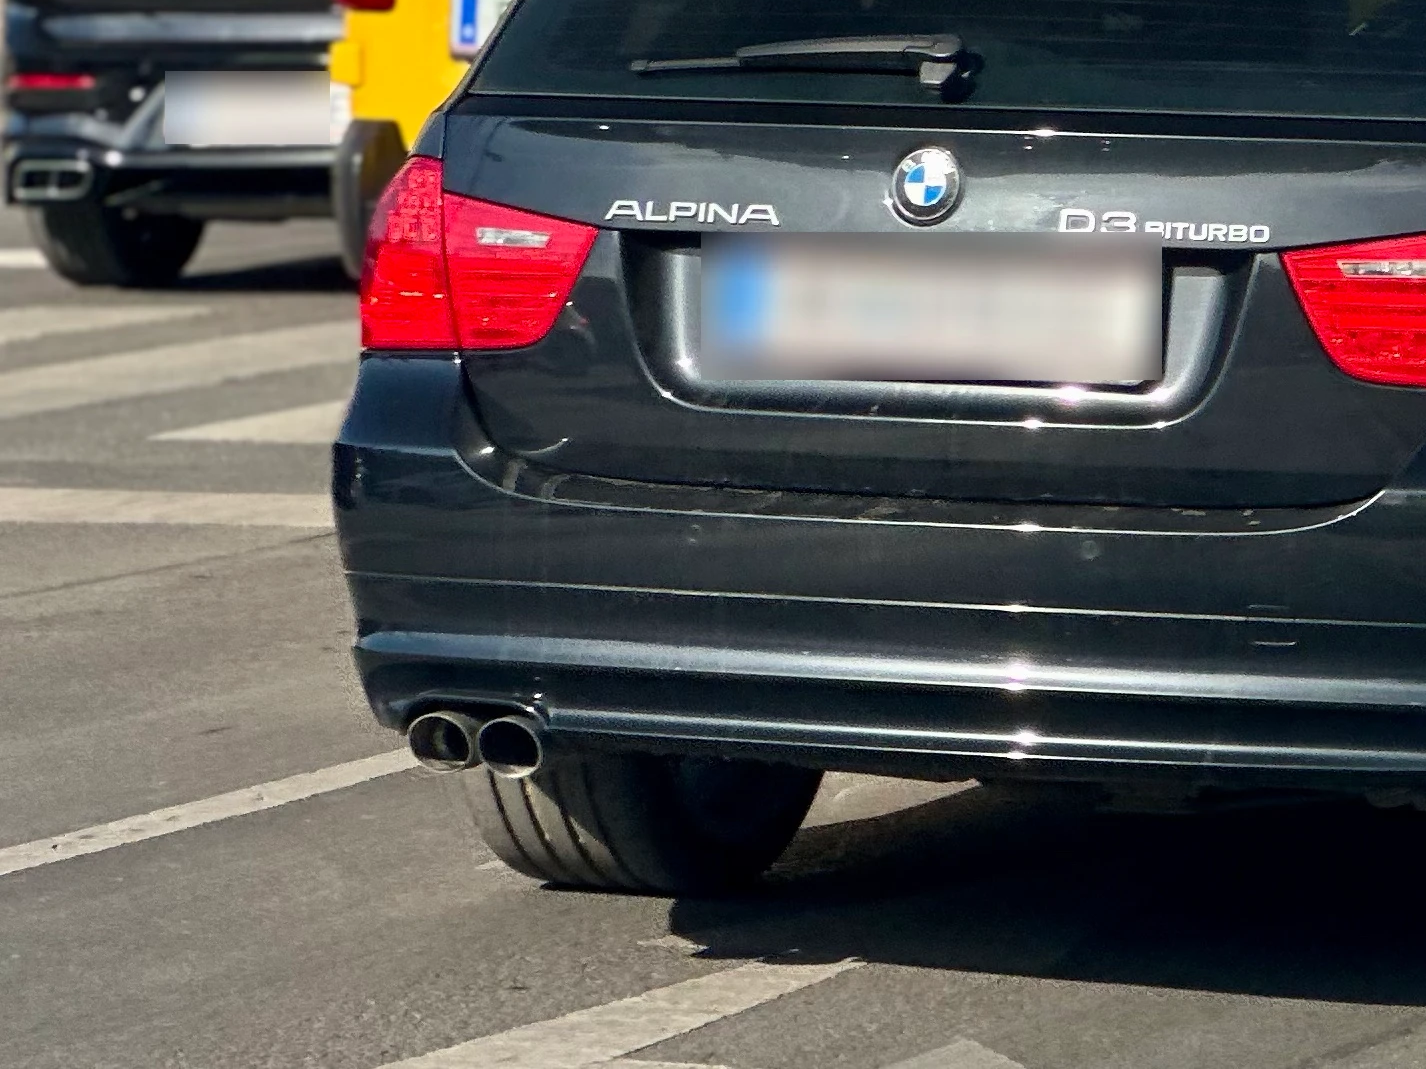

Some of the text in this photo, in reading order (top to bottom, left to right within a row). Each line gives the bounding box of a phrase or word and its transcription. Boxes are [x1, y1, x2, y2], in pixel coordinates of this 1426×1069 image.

[604, 200, 780, 226] ALPINA
[1058, 208, 1270, 243] D3 BITURBO
